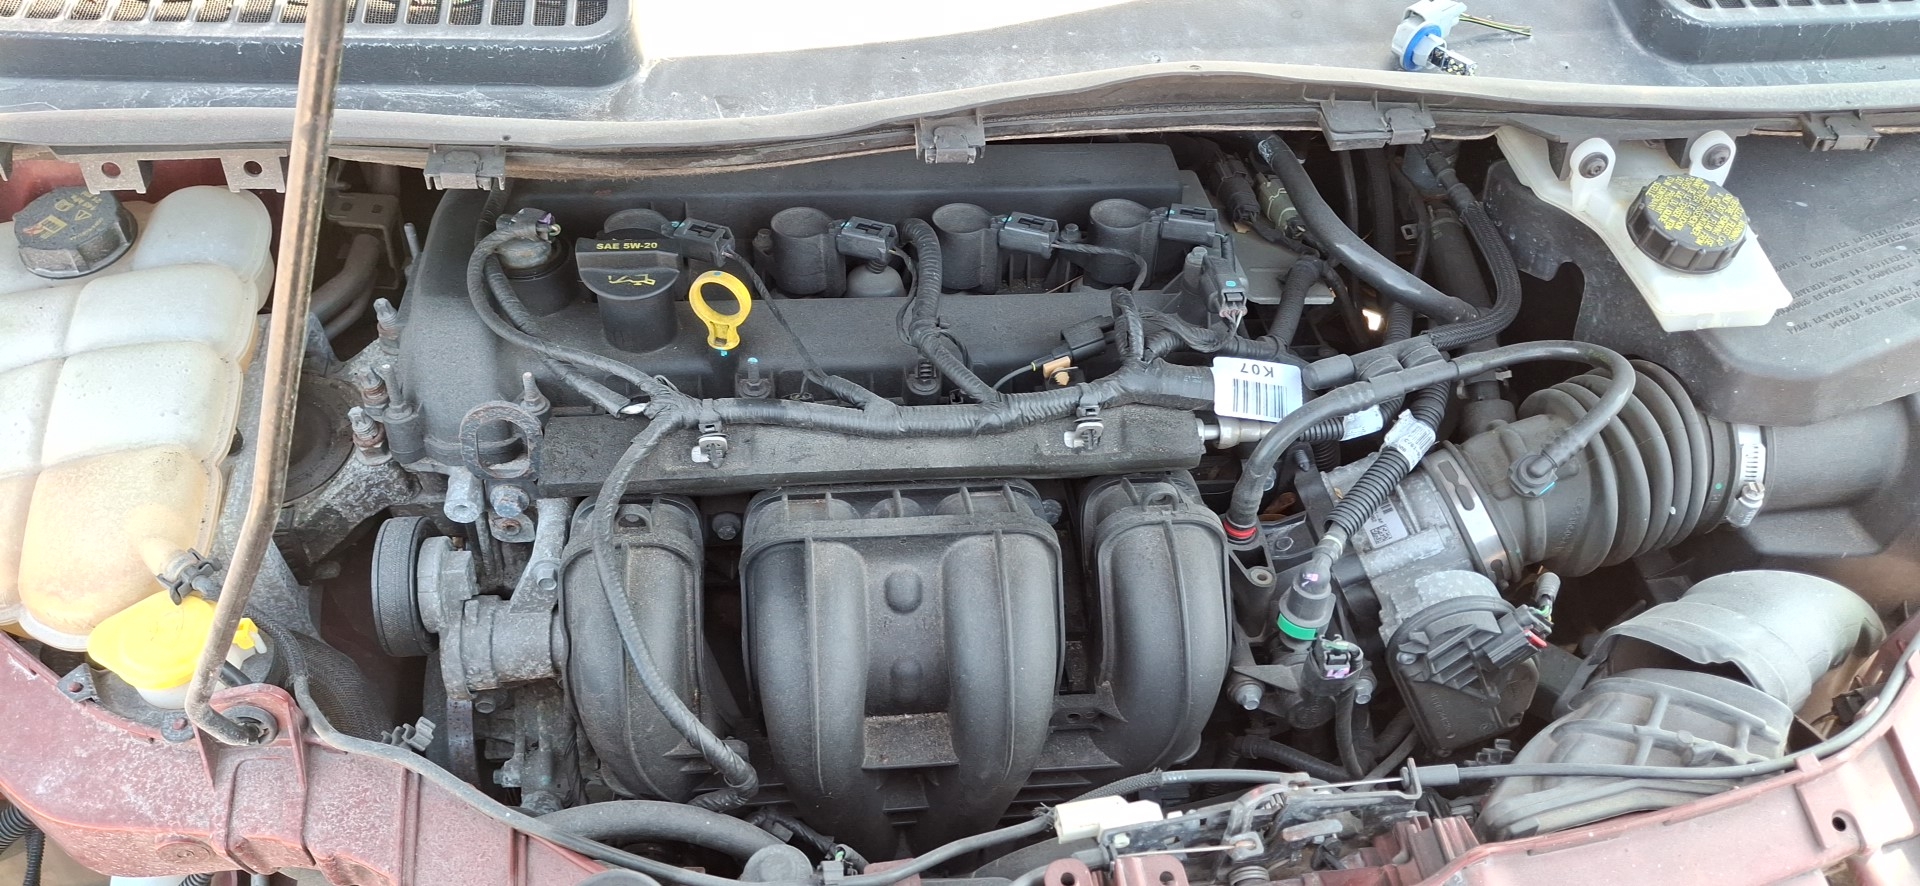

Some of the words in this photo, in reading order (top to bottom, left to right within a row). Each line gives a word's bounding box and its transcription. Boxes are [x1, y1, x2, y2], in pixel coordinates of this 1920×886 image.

[1775, 260, 1798, 272] OVER
[1815, 241, 1850, 257] SERVICE
[1810, 256, 1838, 269] COVER
[1841, 246, 1866, 259] AFTER
[1772, 299, 1811, 318] OUJOURS
[1813, 283, 1852, 301] REPOSER
[1240, 363, 1274, 378] K07
